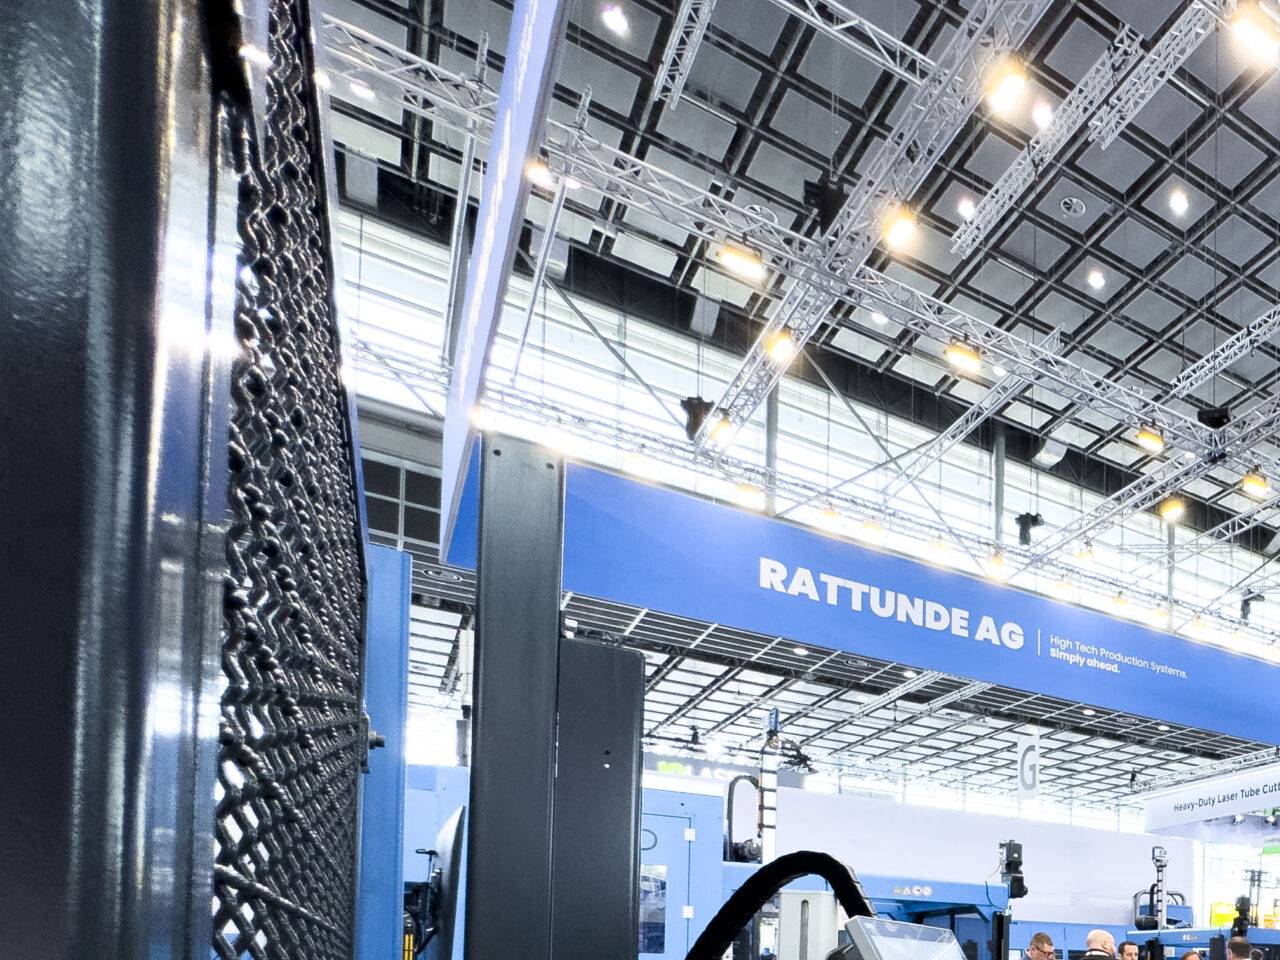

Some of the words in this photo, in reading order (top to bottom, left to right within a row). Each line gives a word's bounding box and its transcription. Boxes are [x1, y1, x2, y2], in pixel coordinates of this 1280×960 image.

[759, 556, 969, 638] RATTUNDE
[974, 615, 1025, 650] AG
[1049, 647, 1085, 667] Simply
[1087, 657, 1120, 674] ahead.
[1050, 634, 1072, 650] High
[1075, 640, 1098, 656] Tech
[1100, 648, 1148, 669] Production
[1150, 661, 1188, 679] Systems.
[1020, 744, 1037, 791] G
[1173, 794, 1216, 813] Heavy-Duty
[1217, 791, 1239, 804] Laser
[1240, 786, 1261, 800] Tube
